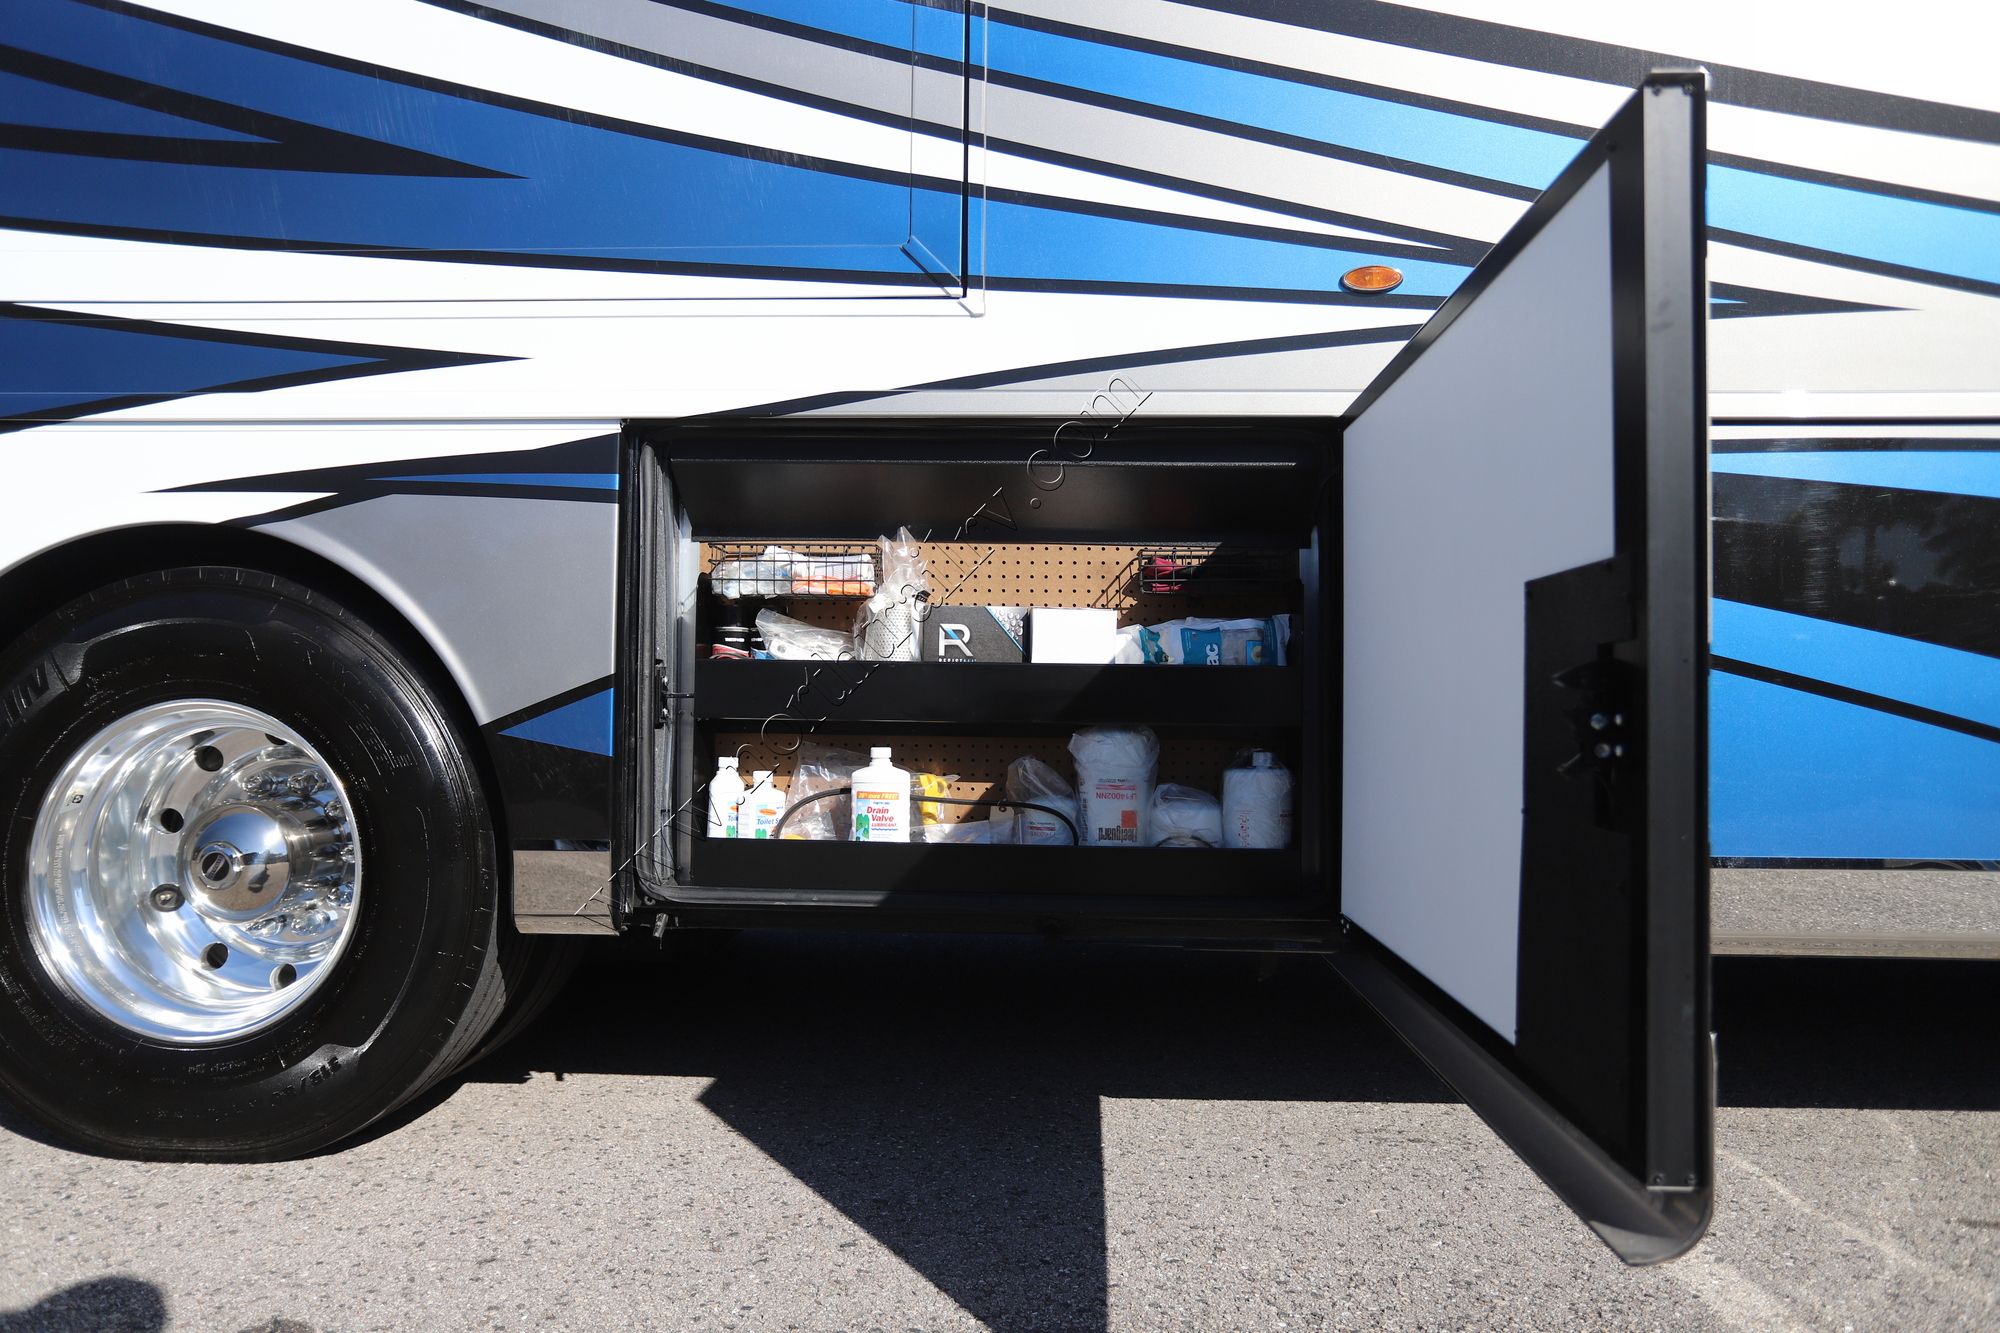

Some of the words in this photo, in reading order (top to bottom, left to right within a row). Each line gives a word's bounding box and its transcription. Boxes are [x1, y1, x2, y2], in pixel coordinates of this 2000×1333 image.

[938, 623, 974, 657] R
[866, 806, 889, 814] Drain
[871, 814, 894, 822] Valve
[1097, 825, 1137, 842] Fleetguard
